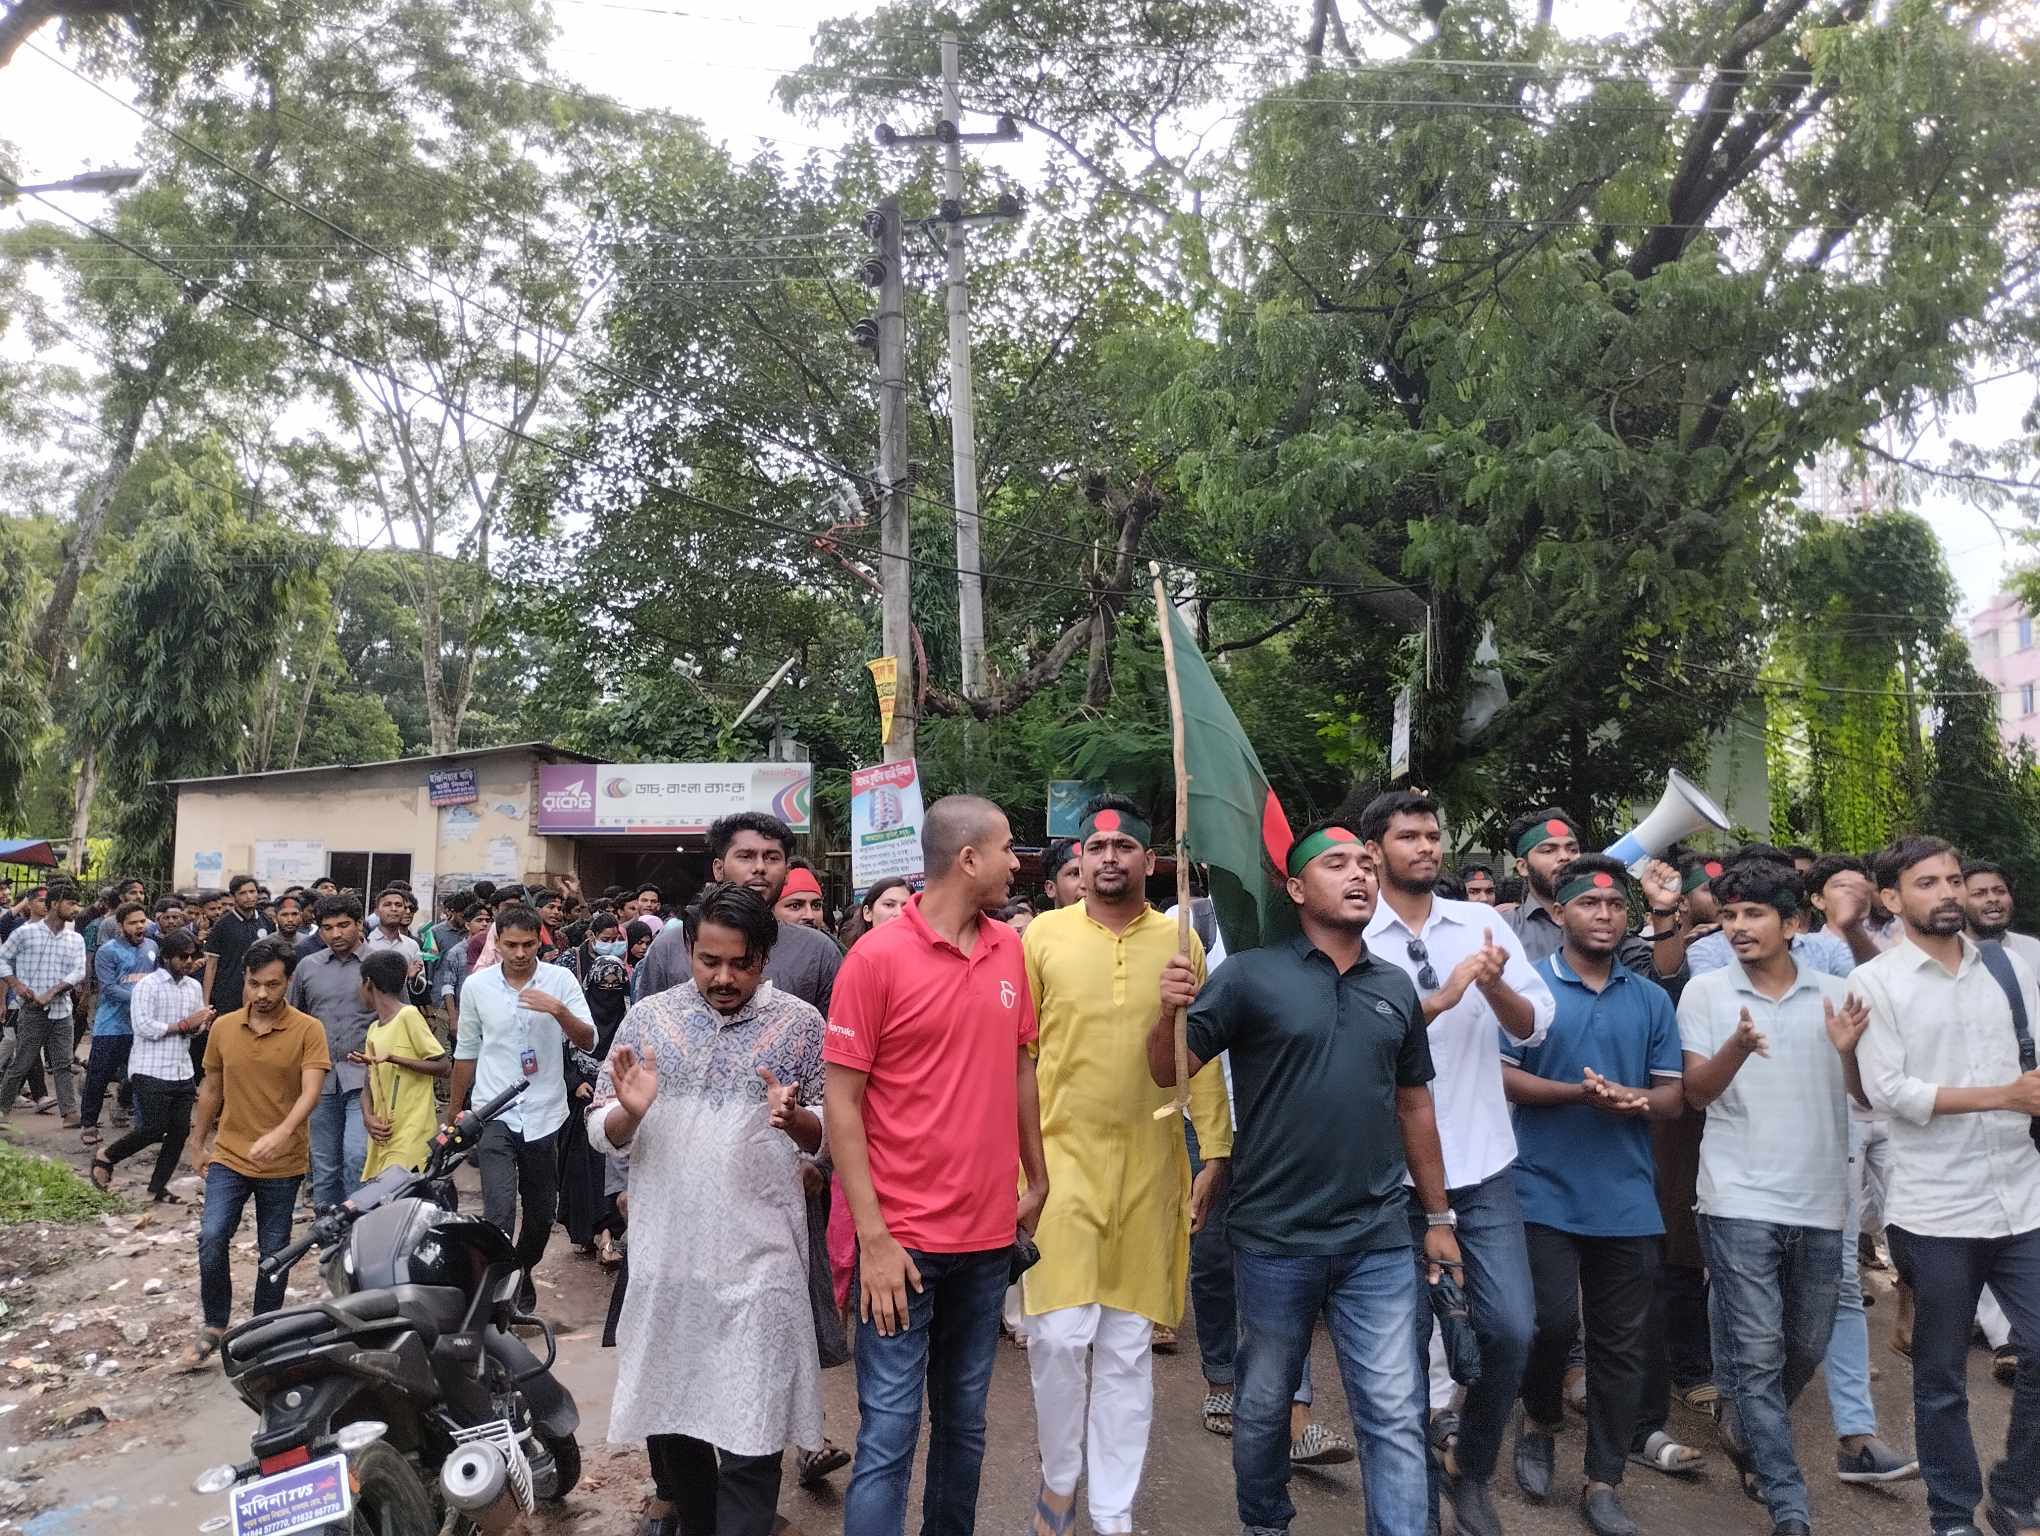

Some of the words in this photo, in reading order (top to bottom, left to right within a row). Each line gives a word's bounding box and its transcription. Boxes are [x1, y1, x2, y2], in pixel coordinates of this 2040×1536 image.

[704, 782, 745, 794] ব্যাংক
[239, 1489, 286, 1516] মদিনা
[287, 1483, 313, 1501] TVS
